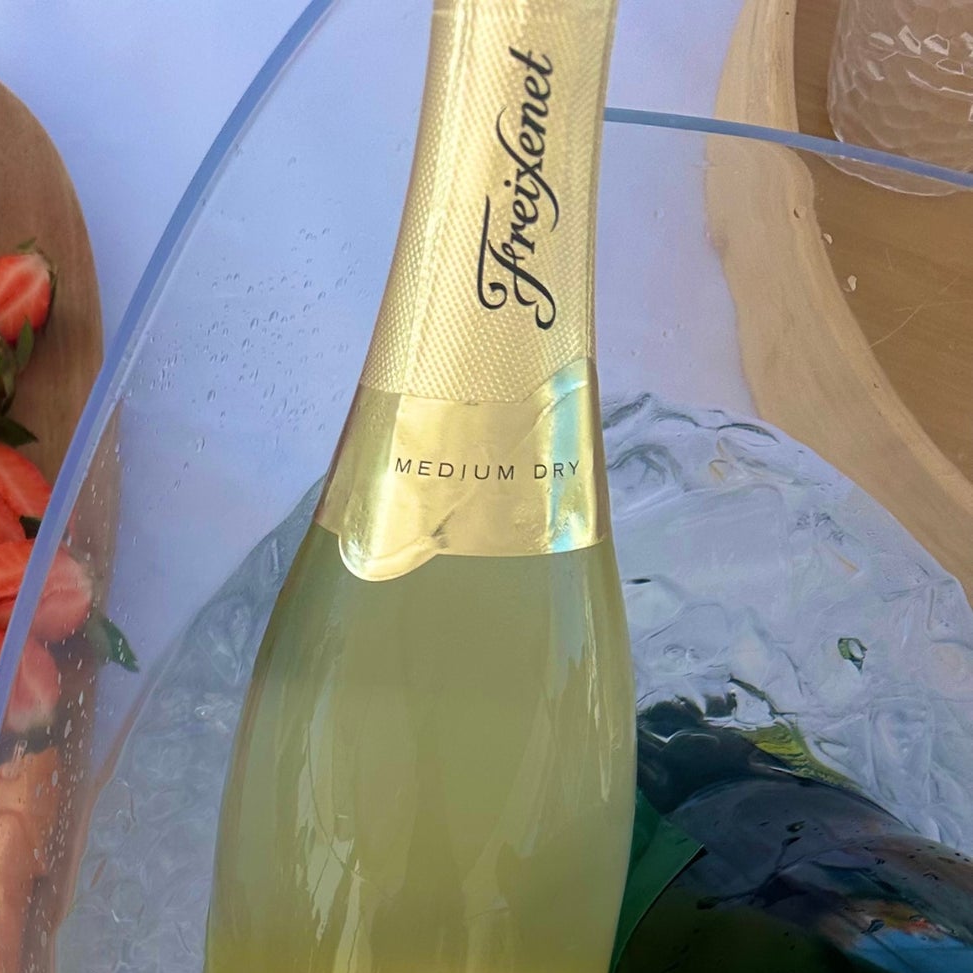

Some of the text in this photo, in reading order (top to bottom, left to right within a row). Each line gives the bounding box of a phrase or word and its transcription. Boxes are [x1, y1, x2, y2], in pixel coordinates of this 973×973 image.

[476, 45, 560, 331] Freixenet
[394, 457, 580, 481] MEDIUM DRY
